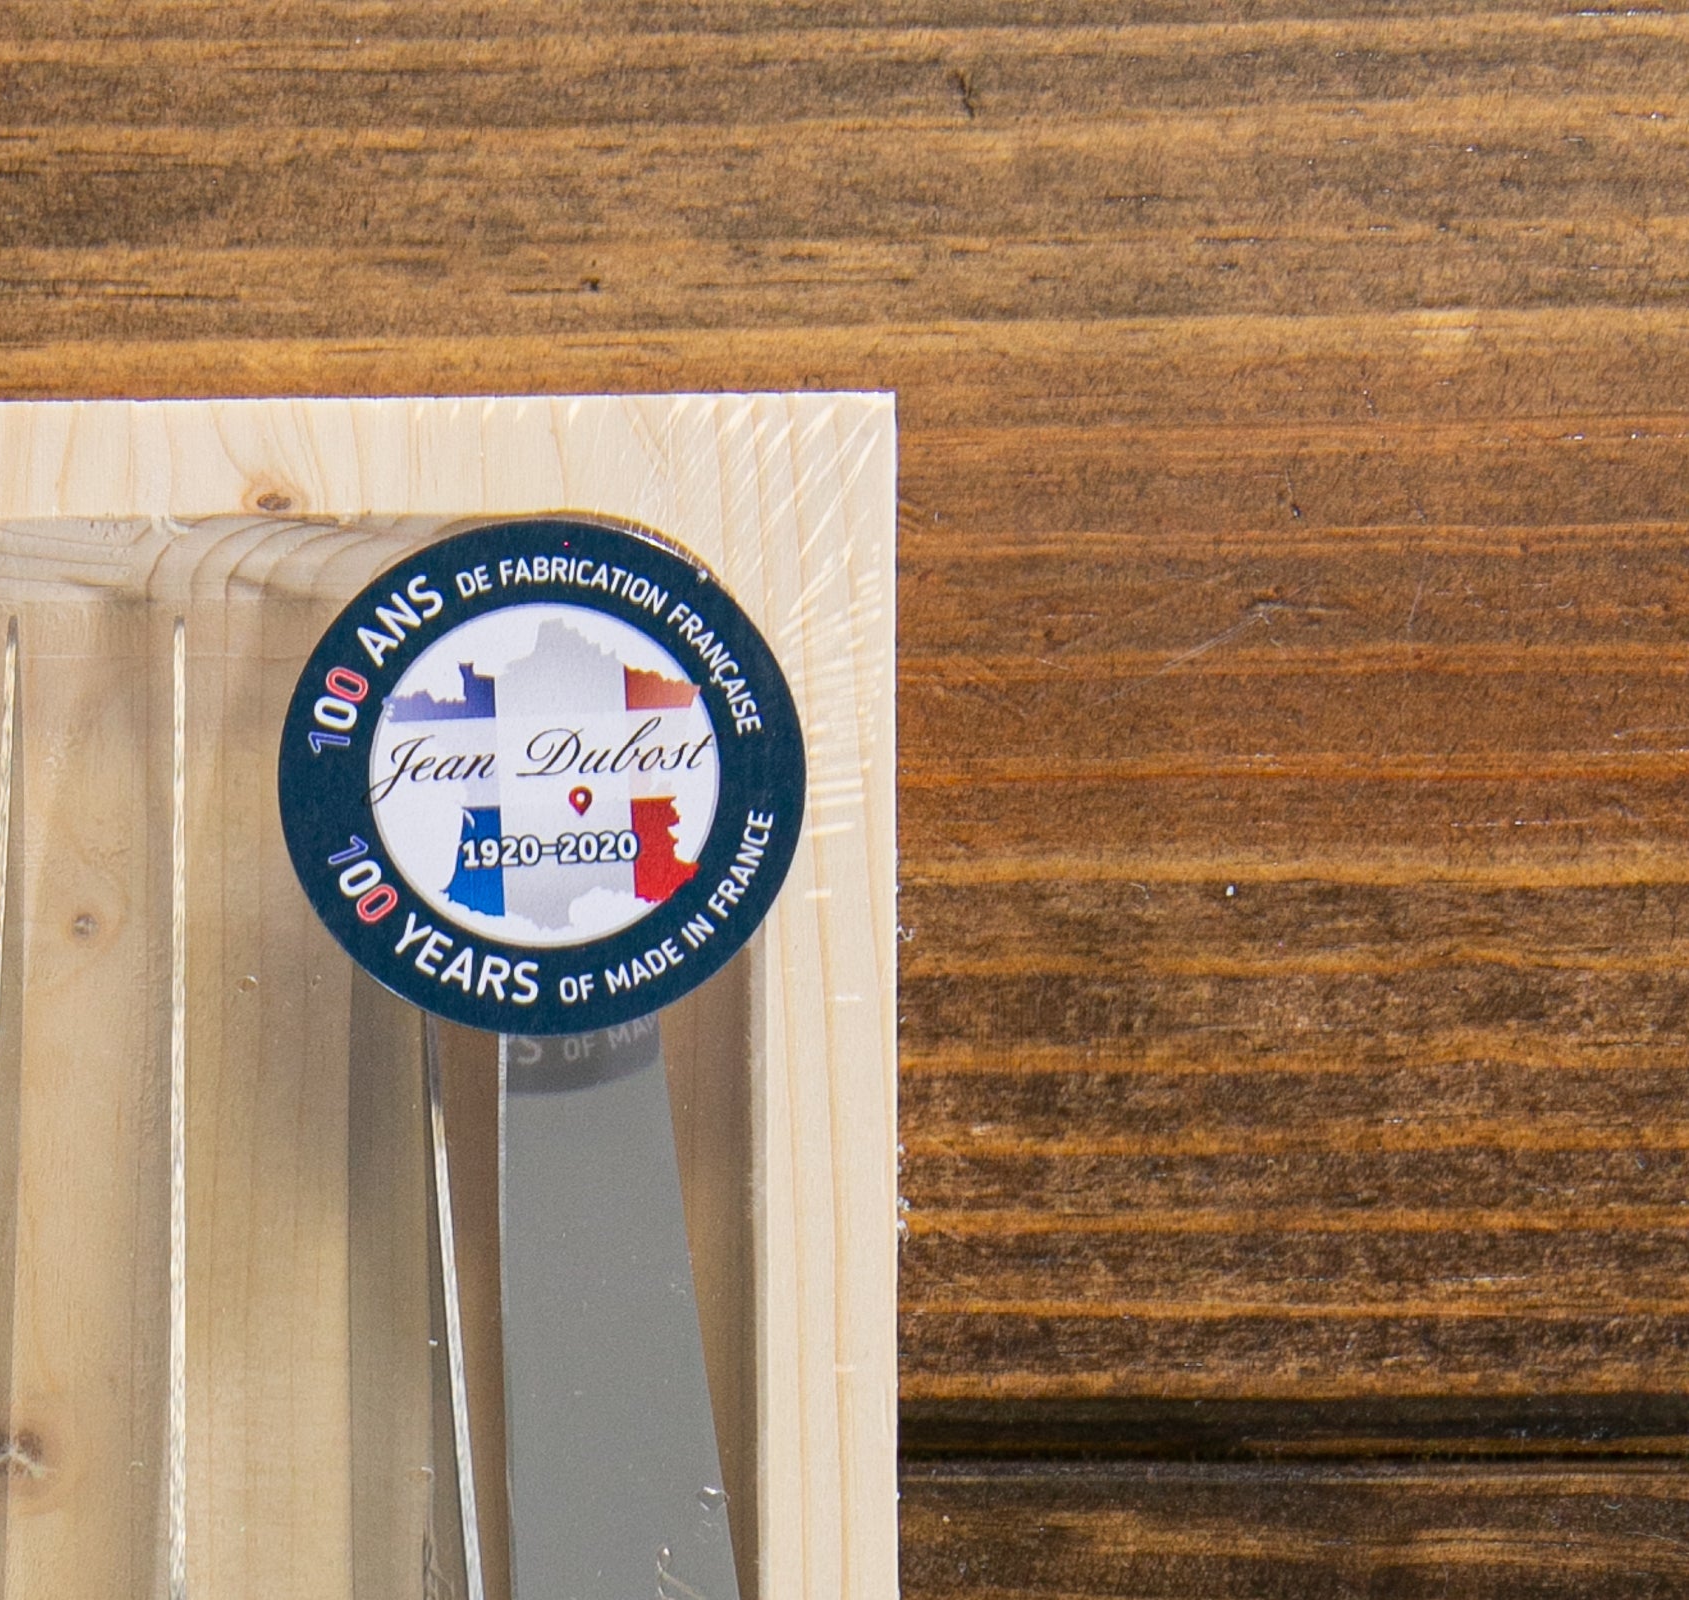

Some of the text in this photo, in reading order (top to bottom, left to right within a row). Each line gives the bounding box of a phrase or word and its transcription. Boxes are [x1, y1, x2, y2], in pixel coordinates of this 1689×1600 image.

[309, 555, 763, 755] 100 ANS DE FABRICATION FRANÇAISE
[362, 716, 714, 804] Jean Dubost
[327, 809, 774, 1004] 100 YEARS OF MADE IN FRANCE
[461, 831, 640, 868] 1920-2020
